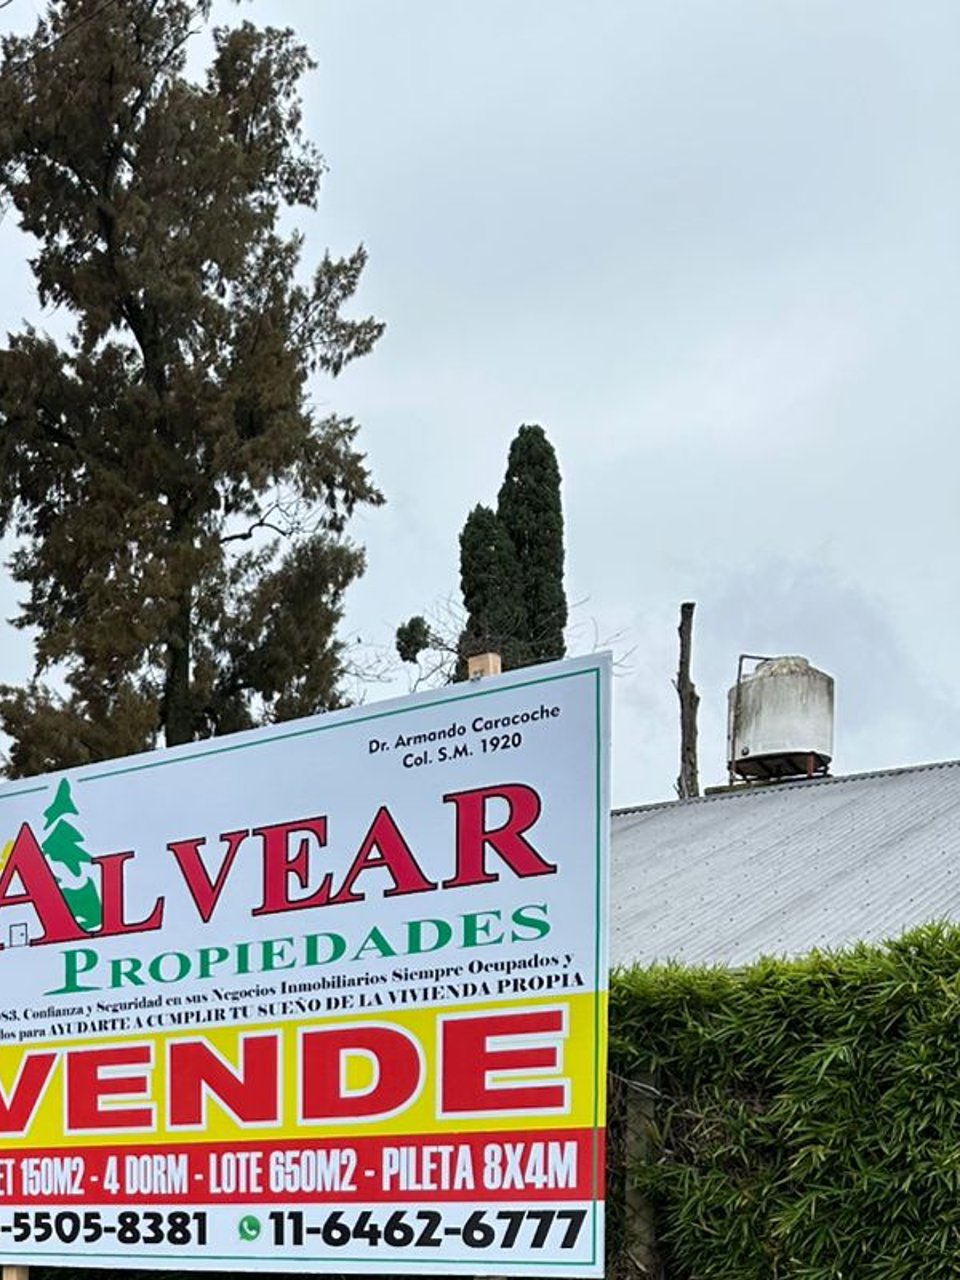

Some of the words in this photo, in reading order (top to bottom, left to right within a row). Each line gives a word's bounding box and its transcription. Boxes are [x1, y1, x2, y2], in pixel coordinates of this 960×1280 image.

[369, 739, 390, 754] Dr.
[395, 722, 466, 749] Armando
[471, 704, 561, 732] Caracoche
[402, 751, 432, 768] Col.
[438, 744, 473, 762] S.M.
[481, 732, 522, 753] 1920
[43, 904, 553, 997] PROPIEDADES
[19, 1026, 46, 1042] para
[49, 1016, 130, 1036] AYUDARTE
[134, 1014, 143, 1029] A
[147, 1007, 226, 1028] CUMPLIR
[229, 1004, 254, 1020] TU
[258, 994, 321, 1016] SUEÑO
[326, 994, 354, 1011] DE
[359, 992, 383, 1007] LA
[388, 981, 491, 1005] VIVIENDA
[497, 972, 585, 994] PROPIA
[23, 1005, 84, 1020] Confianza
[86, 1004, 92, 1016] y
[96, 995, 163, 1013] Seguridad
[165, 996, 182, 1006] en
[185, 993, 208, 1005] sus
[212, 984, 276, 1002] Negocios
[280, 972, 388, 995] Inmobiliarios
[391, 964, 464, 983] Siempre
[468, 953, 559, 974] Ocupados
[563, 953, 574, 968] y
[20, 1156, 85, 1196] 150M2
[103, 1156, 120, 1195] 4
[125, 1153, 189, 1195] DORM
[209, 1150, 263, 1195] LOTE
[269, 1147, 357, 1193] 650M2
[381, 1144, 475, 1191] PILETA
[483, 1140, 578, 1190] 8X4M
[269, 1209, 588, 1249] 11-6462-6777
